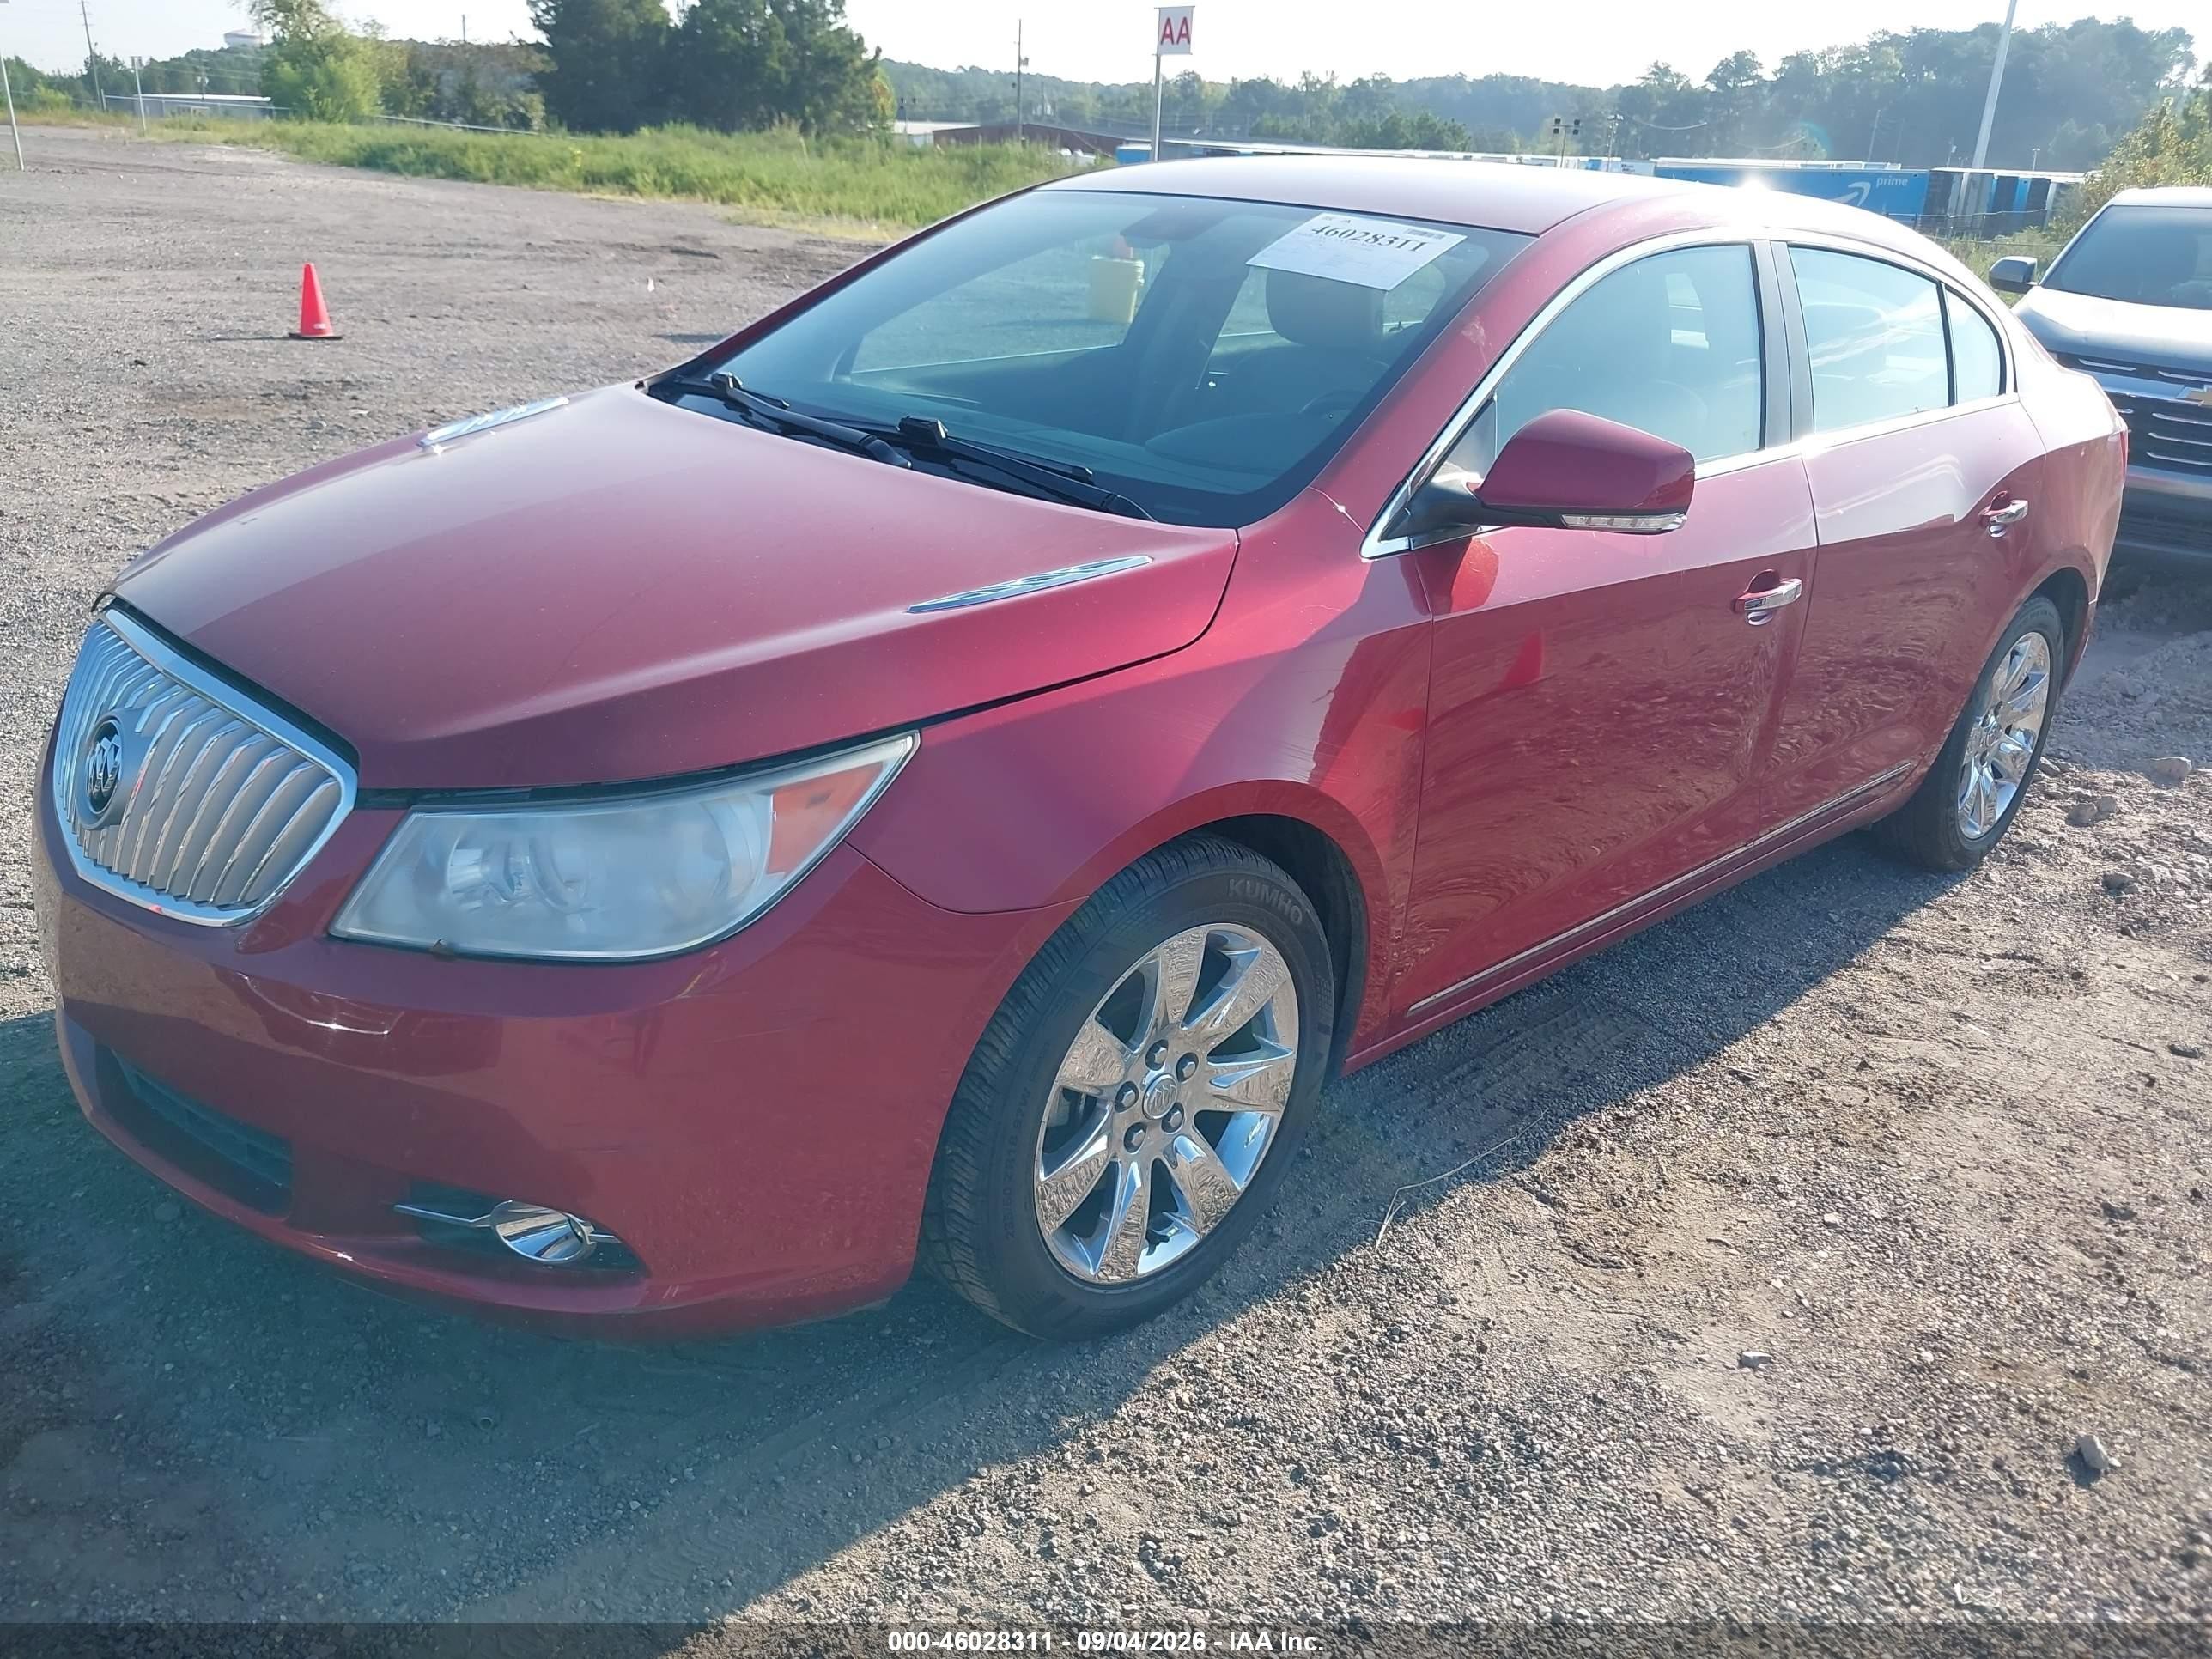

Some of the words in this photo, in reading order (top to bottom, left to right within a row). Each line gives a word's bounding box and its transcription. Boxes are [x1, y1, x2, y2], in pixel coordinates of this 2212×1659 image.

[1160, 16, 1190, 46] AA
[1875, 175, 1908, 188] prime
[1311, 225, 1428, 252] 46028311
[1228, 879, 1303, 924] KUMHO
